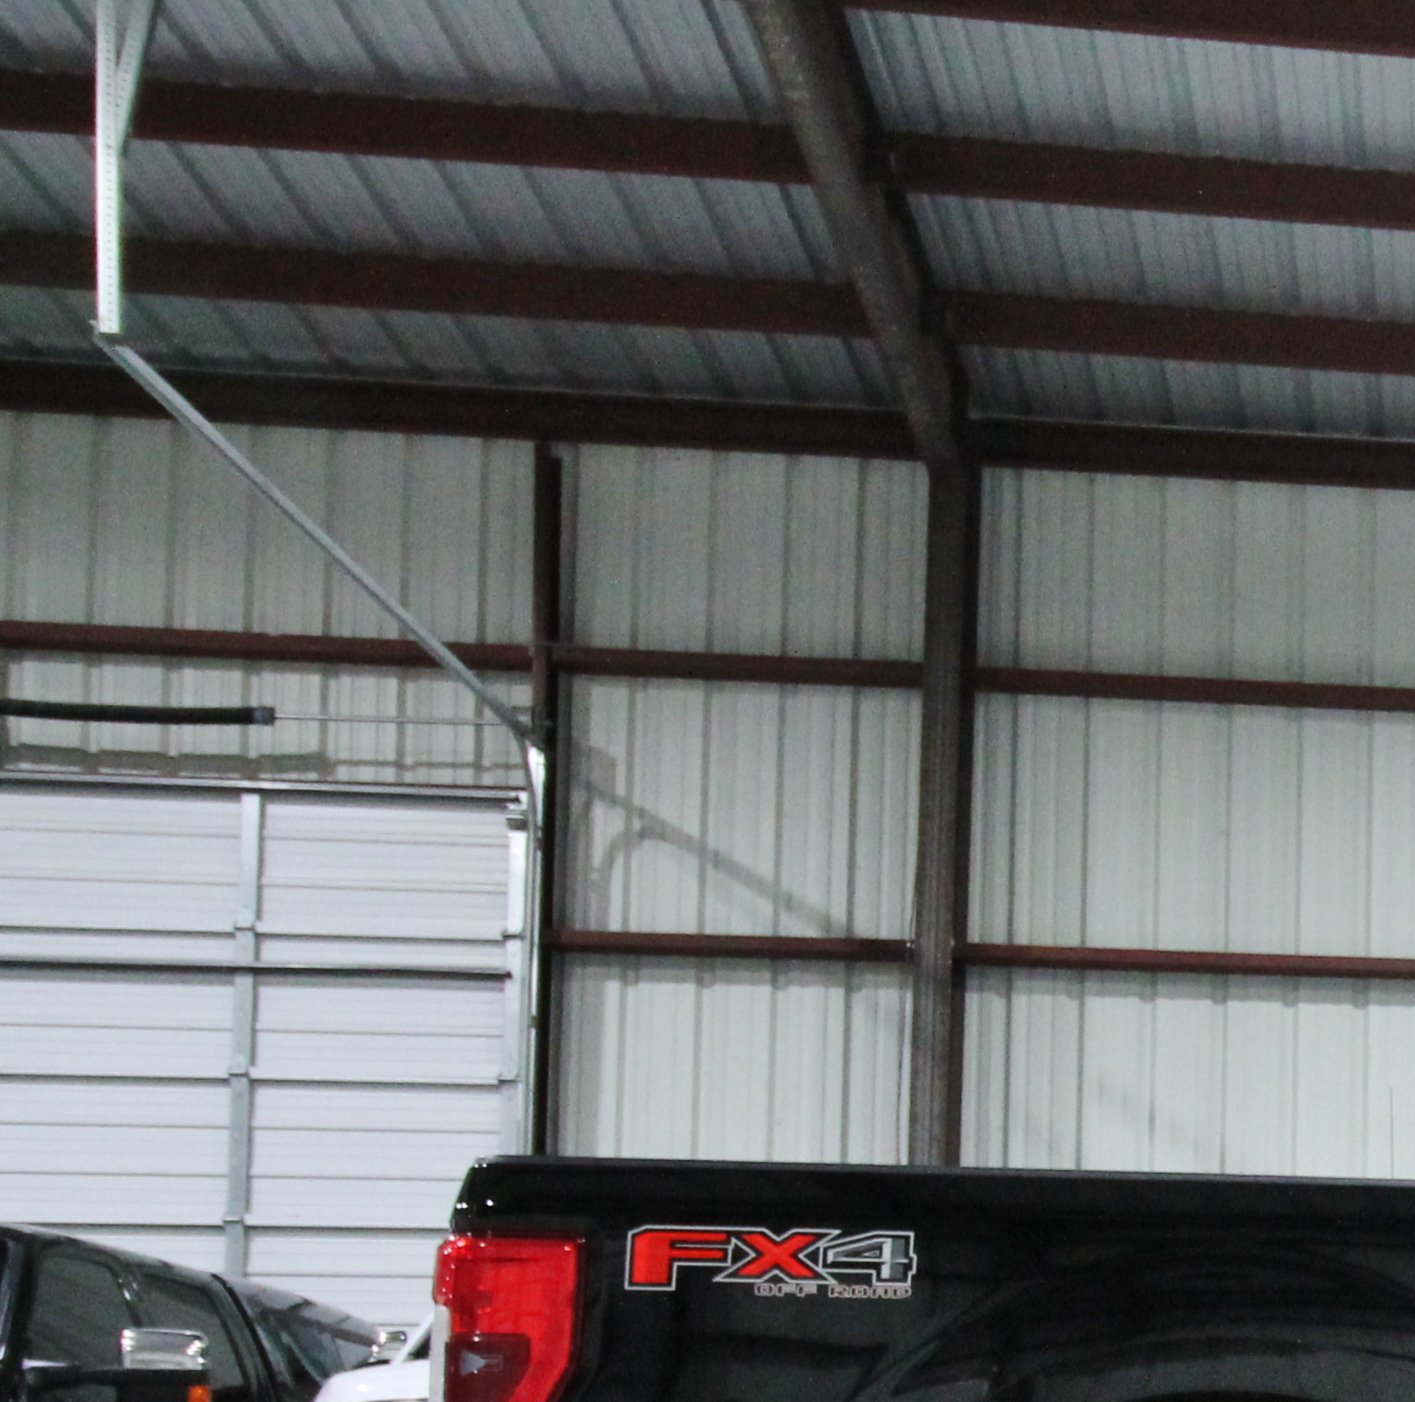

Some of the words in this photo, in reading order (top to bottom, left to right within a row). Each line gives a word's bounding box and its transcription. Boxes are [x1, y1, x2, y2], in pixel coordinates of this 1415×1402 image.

[625, 1225, 917, 1290] FX4
[754, 1283, 818, 1297] OFF
[828, 1285, 912, 1298] ROAD
